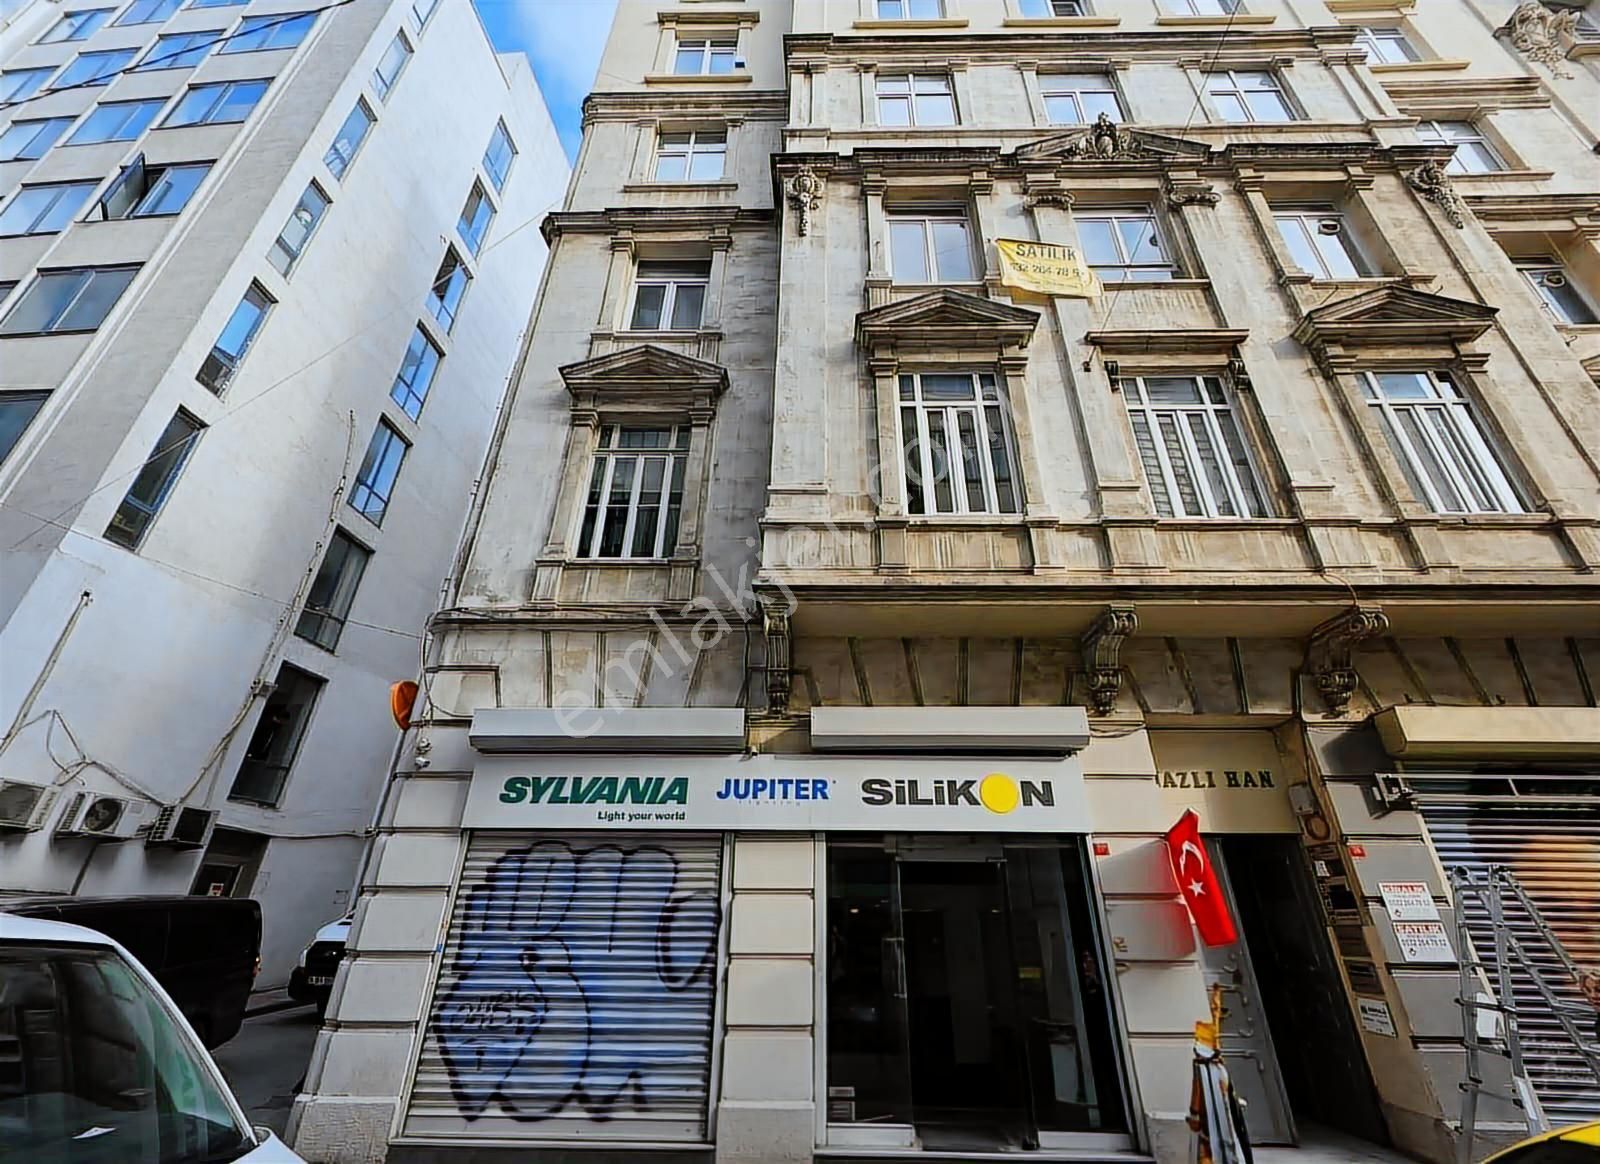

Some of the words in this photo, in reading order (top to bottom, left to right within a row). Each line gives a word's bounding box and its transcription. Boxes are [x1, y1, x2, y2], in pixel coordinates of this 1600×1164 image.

[1016, 243, 1077, 260] SATILIK
[499, 776, 689, 805] SYLVANIA
[716, 778, 829, 800] JUPITER
[597, 811, 625, 821] Light
[628, 812, 652, 822] your
[654, 811, 686, 821] world
